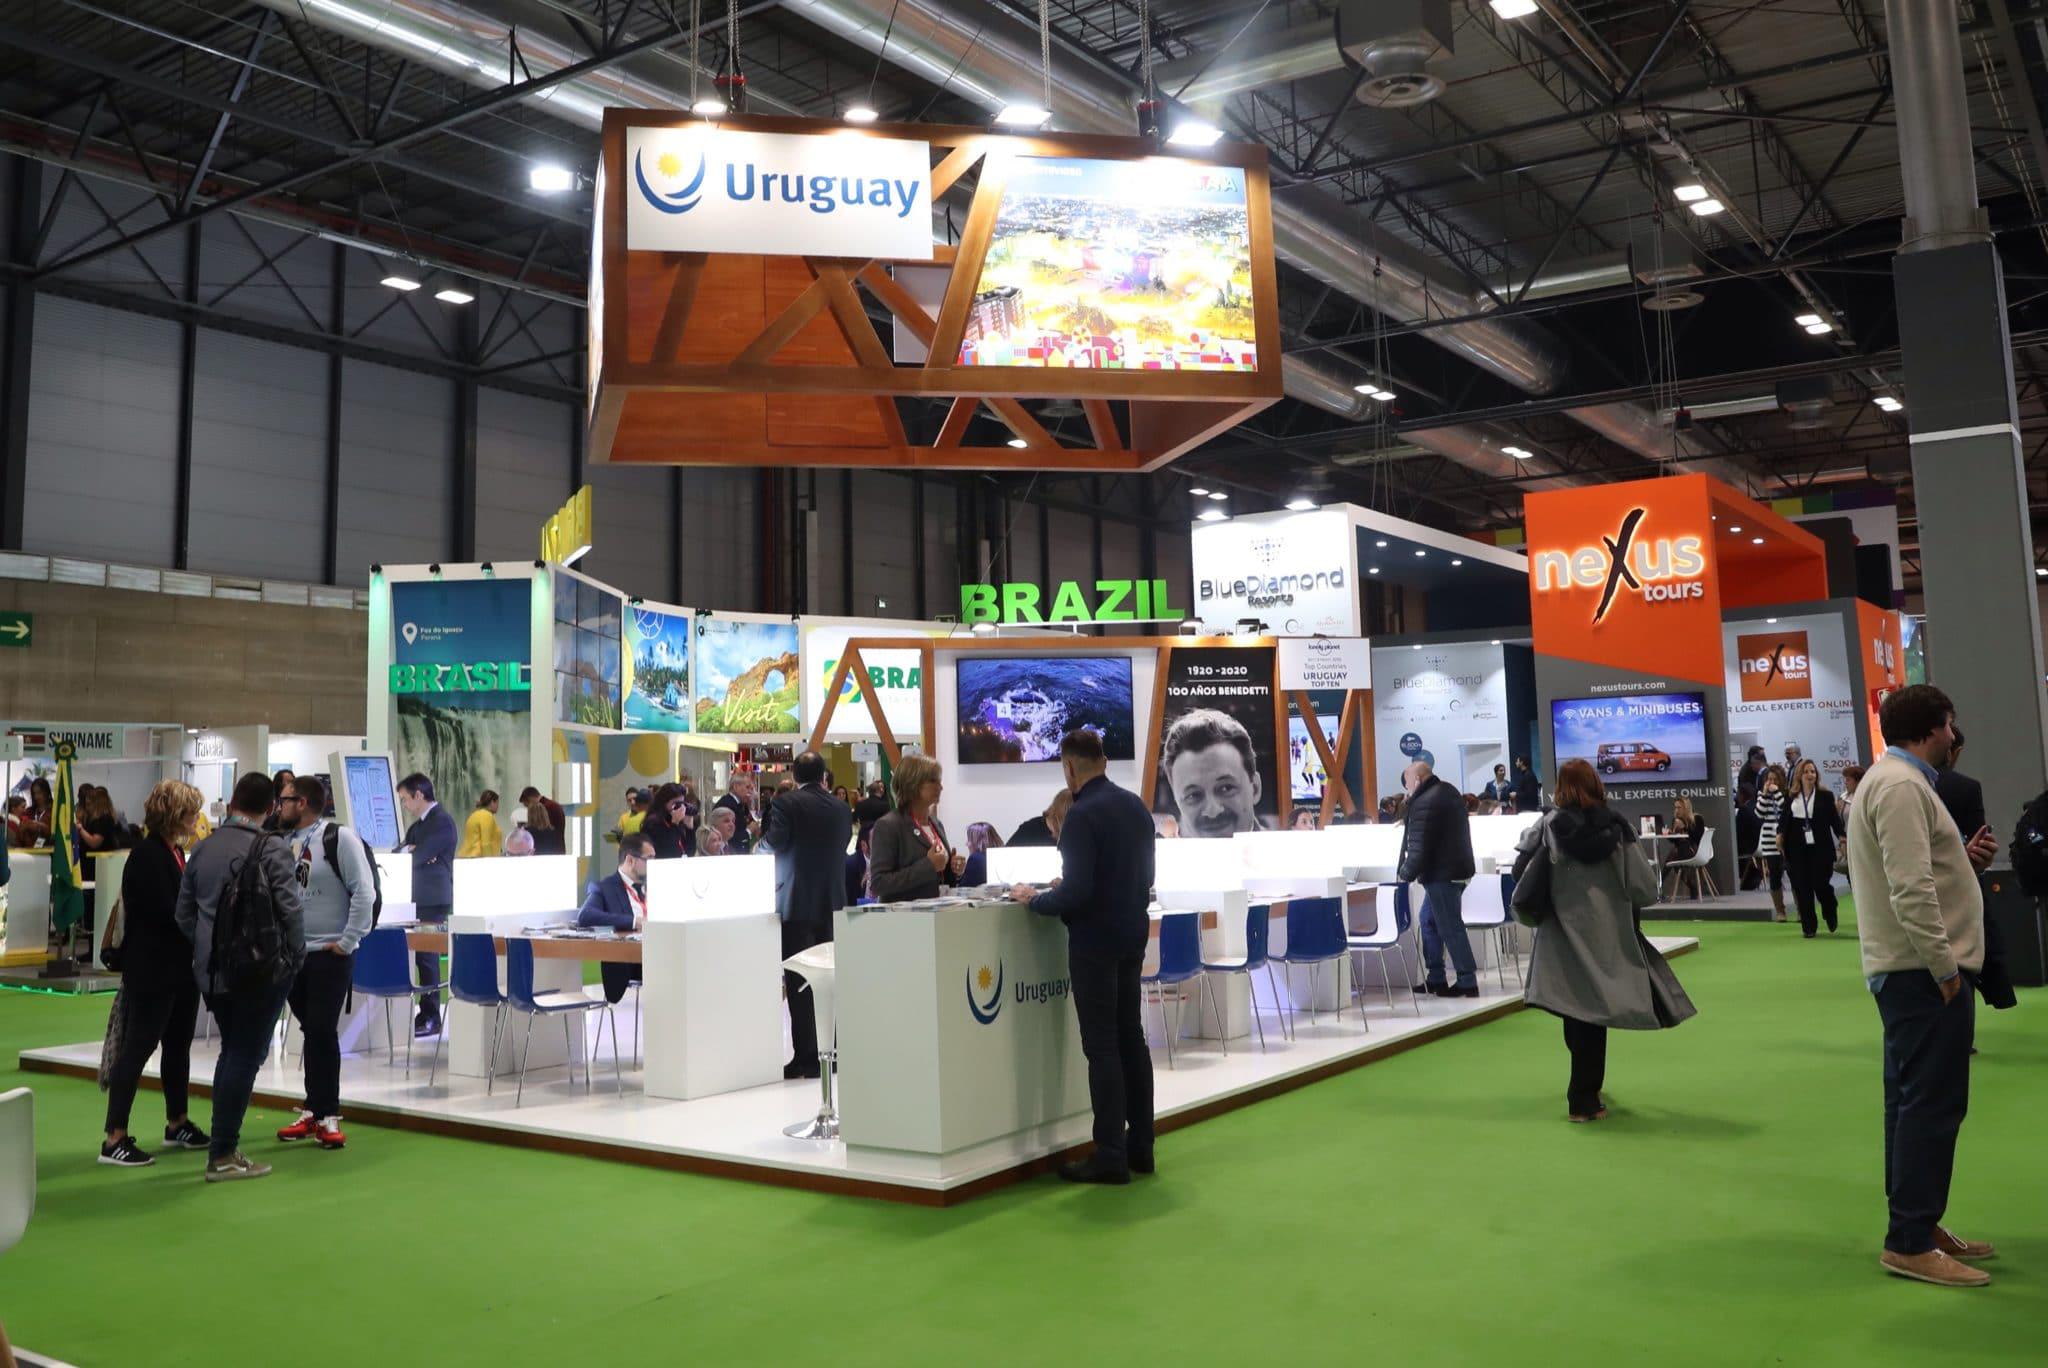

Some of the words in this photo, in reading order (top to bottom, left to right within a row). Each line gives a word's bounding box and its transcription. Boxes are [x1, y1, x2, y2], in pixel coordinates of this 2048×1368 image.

[726, 163, 920, 218] Uruguay
[1642, 581, 1704, 601] tours
[961, 579, 1185, 624] BRAZIL
[389, 661, 531, 694] BRASIL
[1187, 665, 1213, 675] 1920
[1303, 672, 1348, 680] URUGUAY
[1783, 671, 1808, 680] tours
[1168, 687, 1189, 696] 100
[1190, 685, 1217, 696] AÑOS
[1218, 686, 1269, 696] BENEDETTI
[1590, 681, 1666, 693] nexustours.com
[723, 688, 780, 727] Visit
[1578, 706, 1613, 719] VANS
[1616, 706, 1625, 717] &
[1628, 702, 1700, 716] MINIBUSES
[1735, 704, 1768, 713] LOCAL
[1770, 702, 1816, 712] EXPERTS
[1624, 789, 1678, 801] EXPERTS
[1680, 787, 1727, 797] ONLINE
[1015, 978, 1071, 1004] Uruguay
